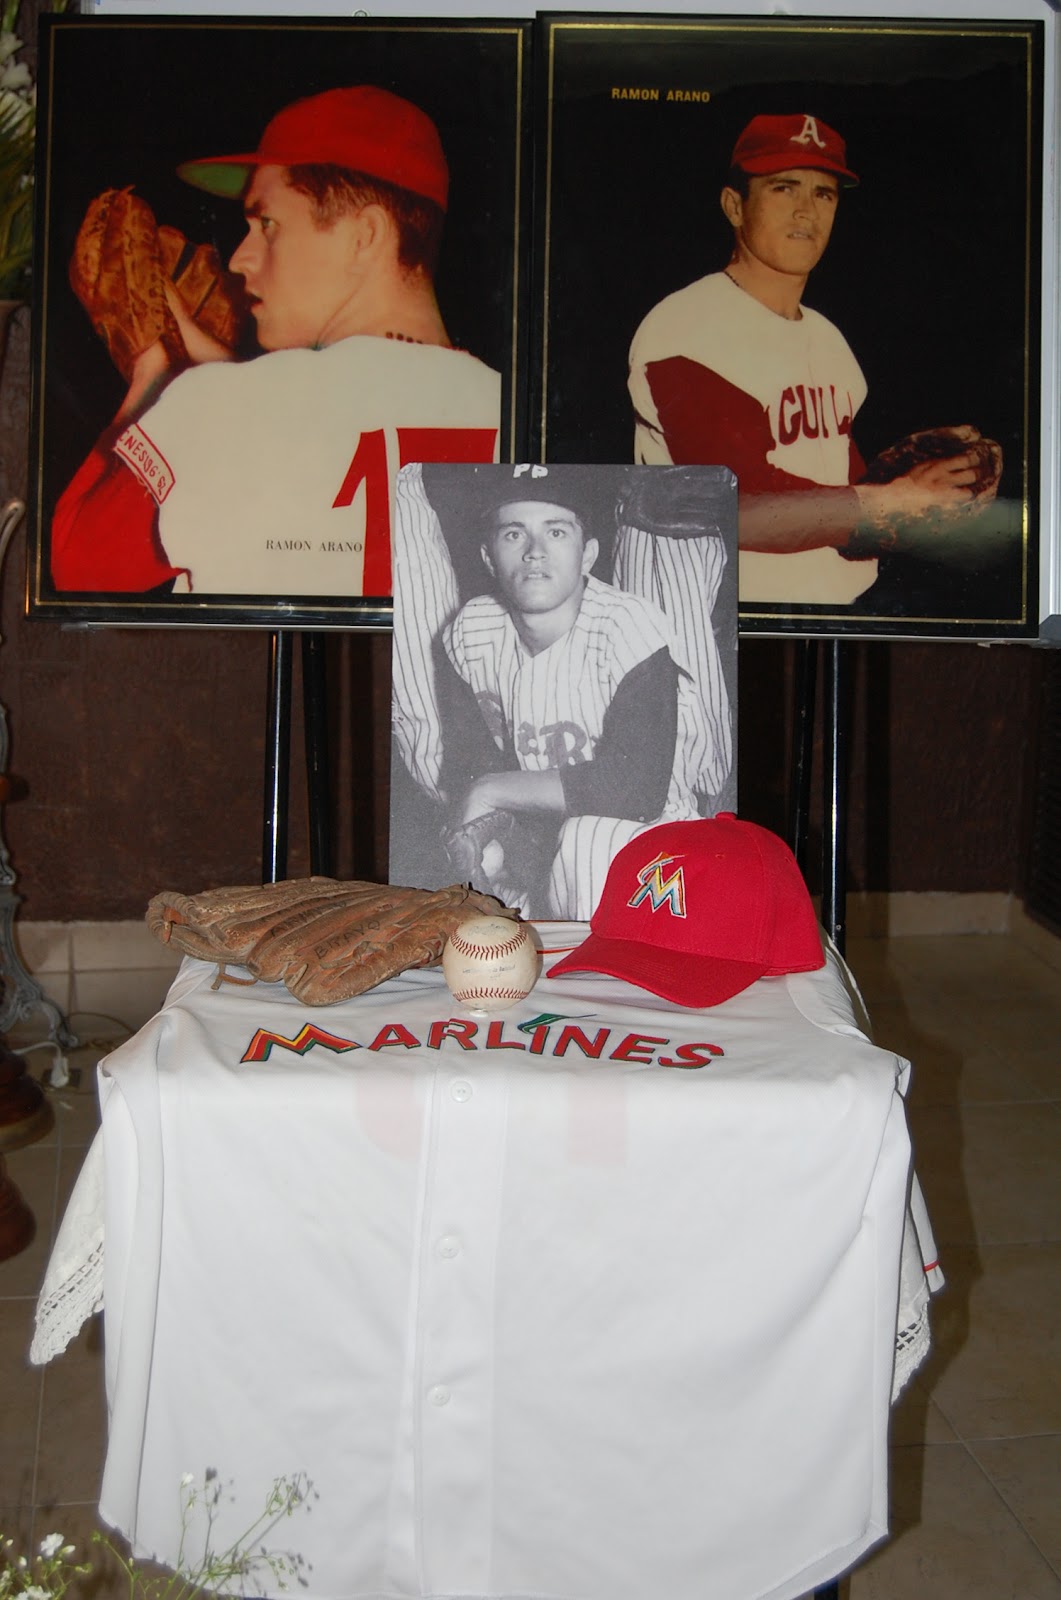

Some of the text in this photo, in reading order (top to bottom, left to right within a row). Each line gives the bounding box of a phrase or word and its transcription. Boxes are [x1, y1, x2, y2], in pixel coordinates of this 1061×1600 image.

[611, 88, 710, 103] RAMON ARANO
[790, 114, 826, 149] A
[265, 539, 363, 553] RAMON ARANO
[626, 851, 687, 919] M
[240, 1013, 725, 1069] MARLINES
